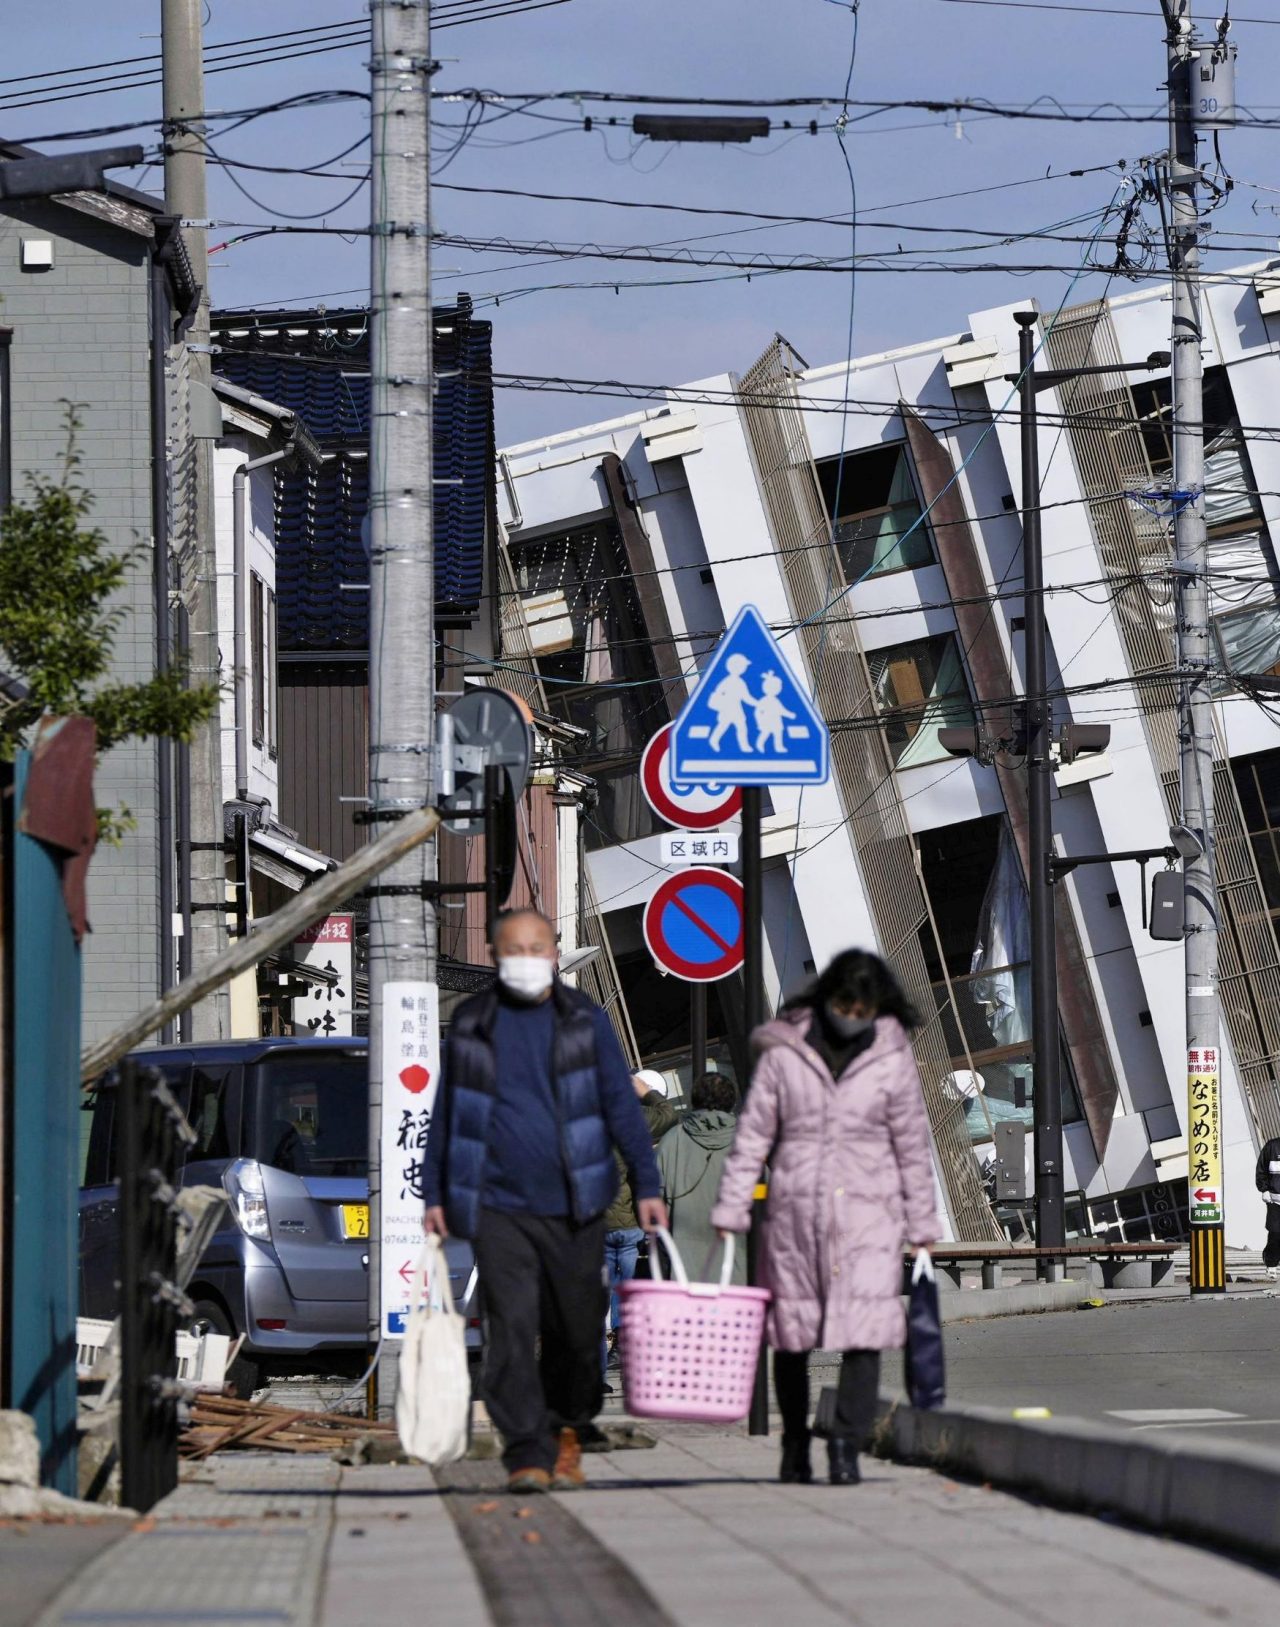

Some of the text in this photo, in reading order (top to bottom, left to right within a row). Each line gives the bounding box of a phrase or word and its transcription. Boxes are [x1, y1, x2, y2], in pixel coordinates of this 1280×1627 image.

[1200, 98, 1218, 114] 30
[671, 840, 729, 857] 区域内
[401, 995, 415, 1058] 輪島塗
[417, 996, 430, 1059] 能登半島
[1188, 1050, 1216, 1063] 無料
[1187, 1064, 1217, 1073] 朝市通り
[1191, 1079, 1210, 1182] なつめの店
[396, 1108, 430, 1200] 稲忠
[1194, 1209, 1215, 1218] 河井町
